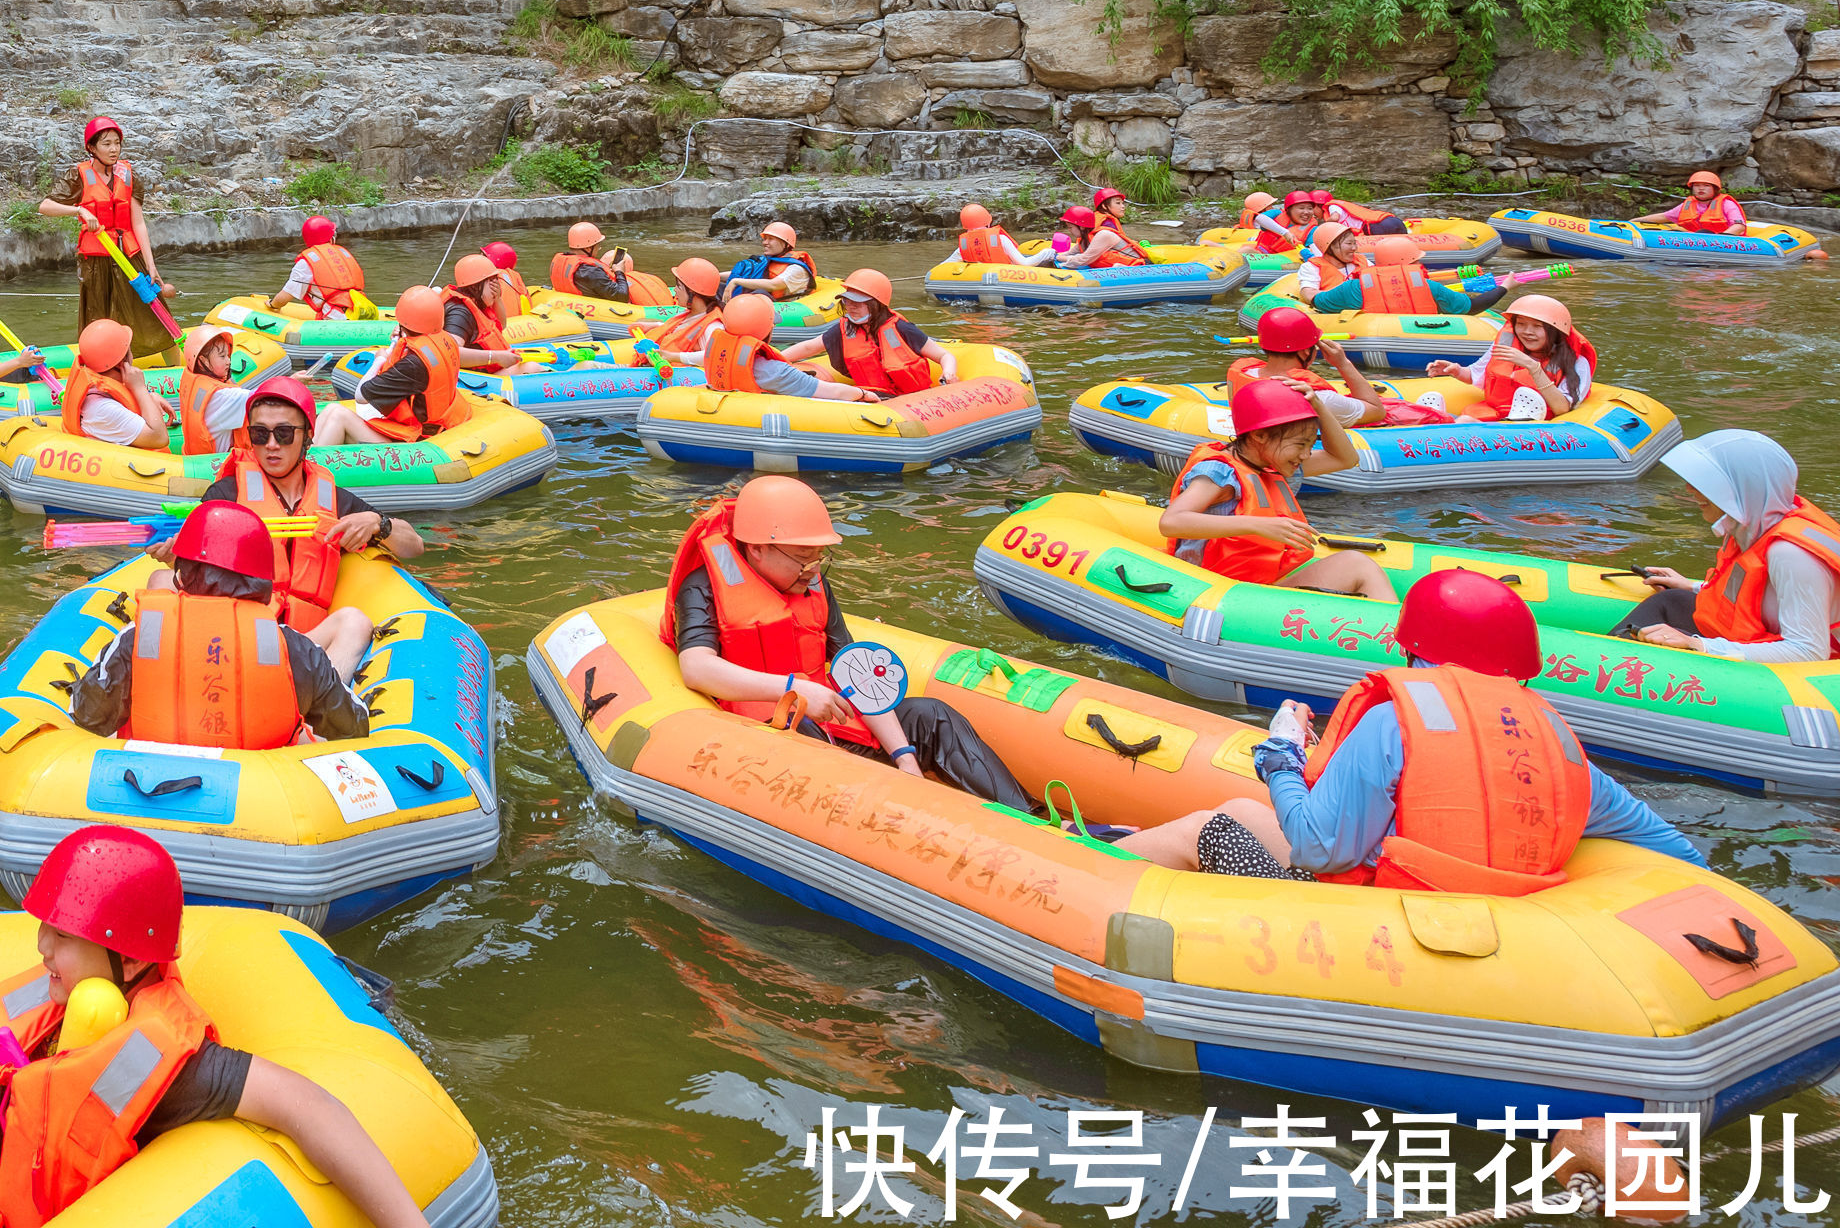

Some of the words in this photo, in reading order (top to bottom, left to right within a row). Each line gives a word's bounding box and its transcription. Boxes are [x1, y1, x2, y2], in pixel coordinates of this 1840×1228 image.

[1548, 217, 1586, 233] 0536
[999, 268, 1038, 282] 0290
[1397, 428, 1587, 460] 乐谷银滩峡谷漂流
[39, 448, 103, 477] 0166
[1003, 525, 1091, 576] 0391
